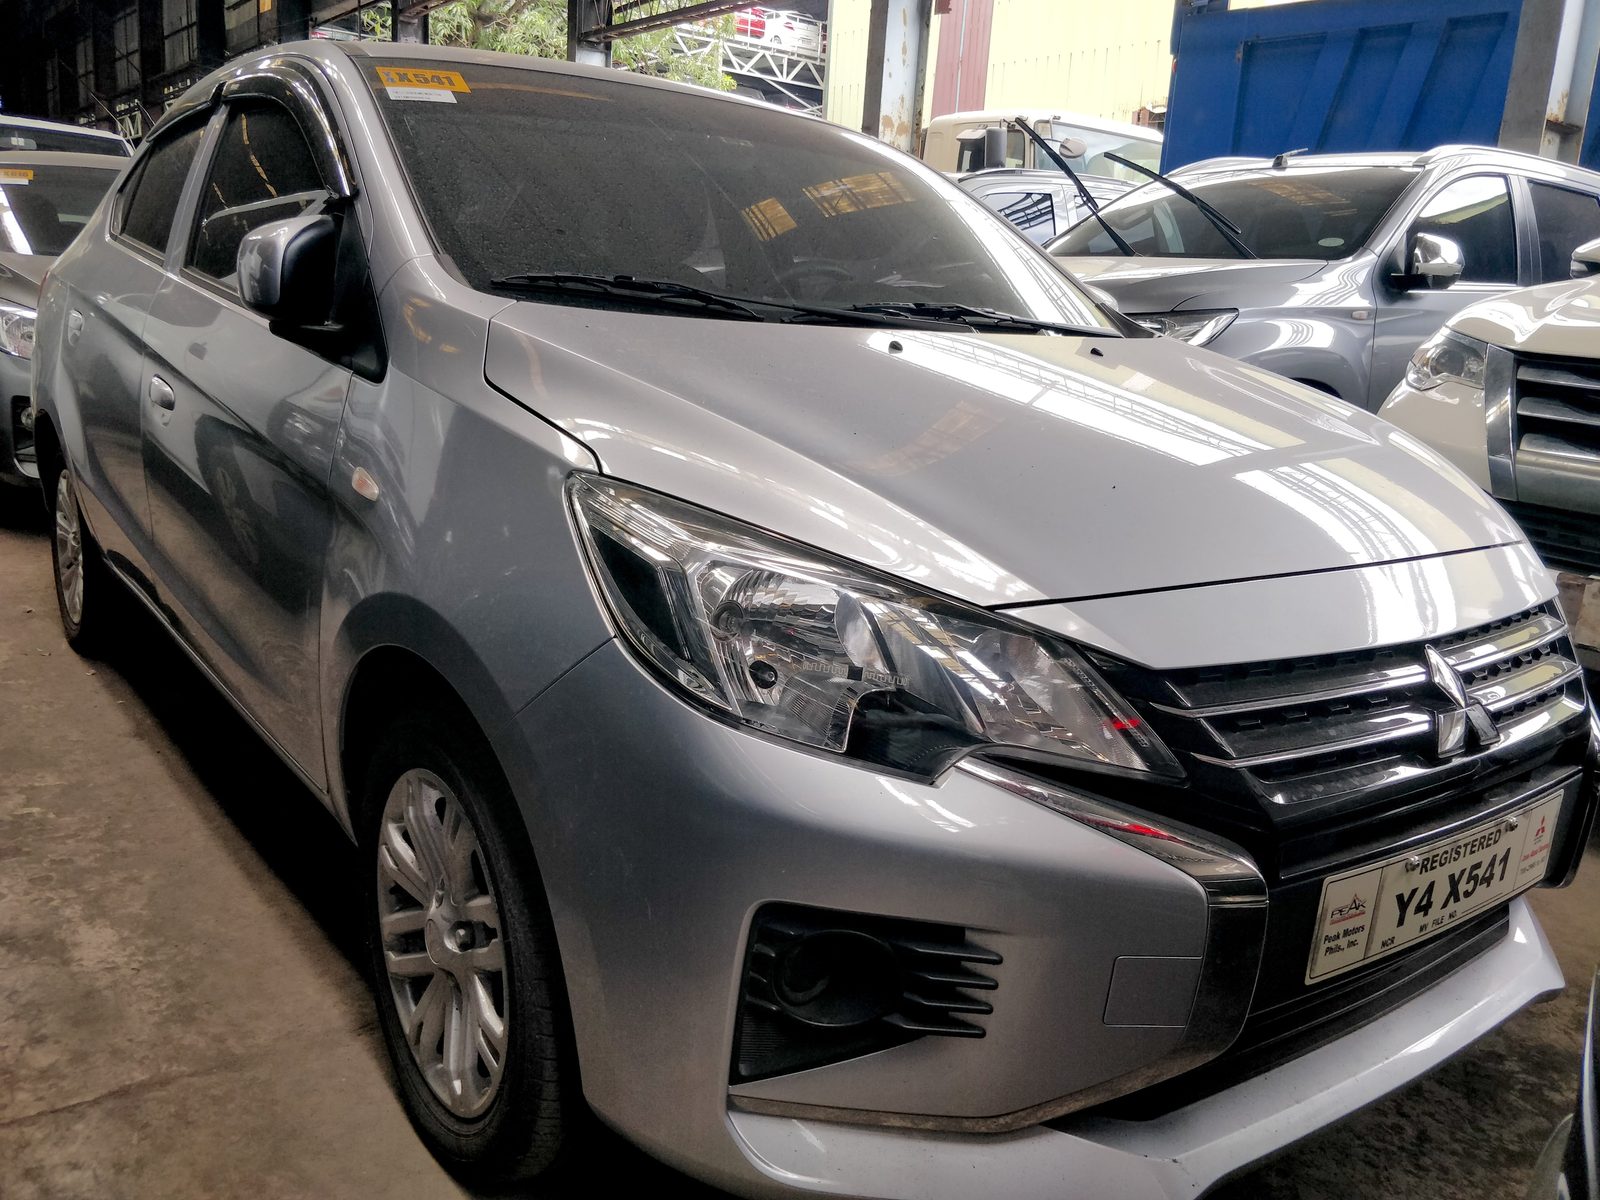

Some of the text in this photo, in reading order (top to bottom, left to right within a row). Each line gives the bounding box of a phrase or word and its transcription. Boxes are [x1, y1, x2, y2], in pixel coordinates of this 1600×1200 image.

[1419, 829, 1502, 875] REGISTERED
[1395, 847, 1511, 928] Y4 X541
[1330, 898, 1367, 919] PEAK
[1432, 916, 1444, 928] FILE
[1324, 925, 1365, 944] Peak Motors
[1347, 939, 1358, 948] Inc.
[1381, 936, 1395, 949] NCR
